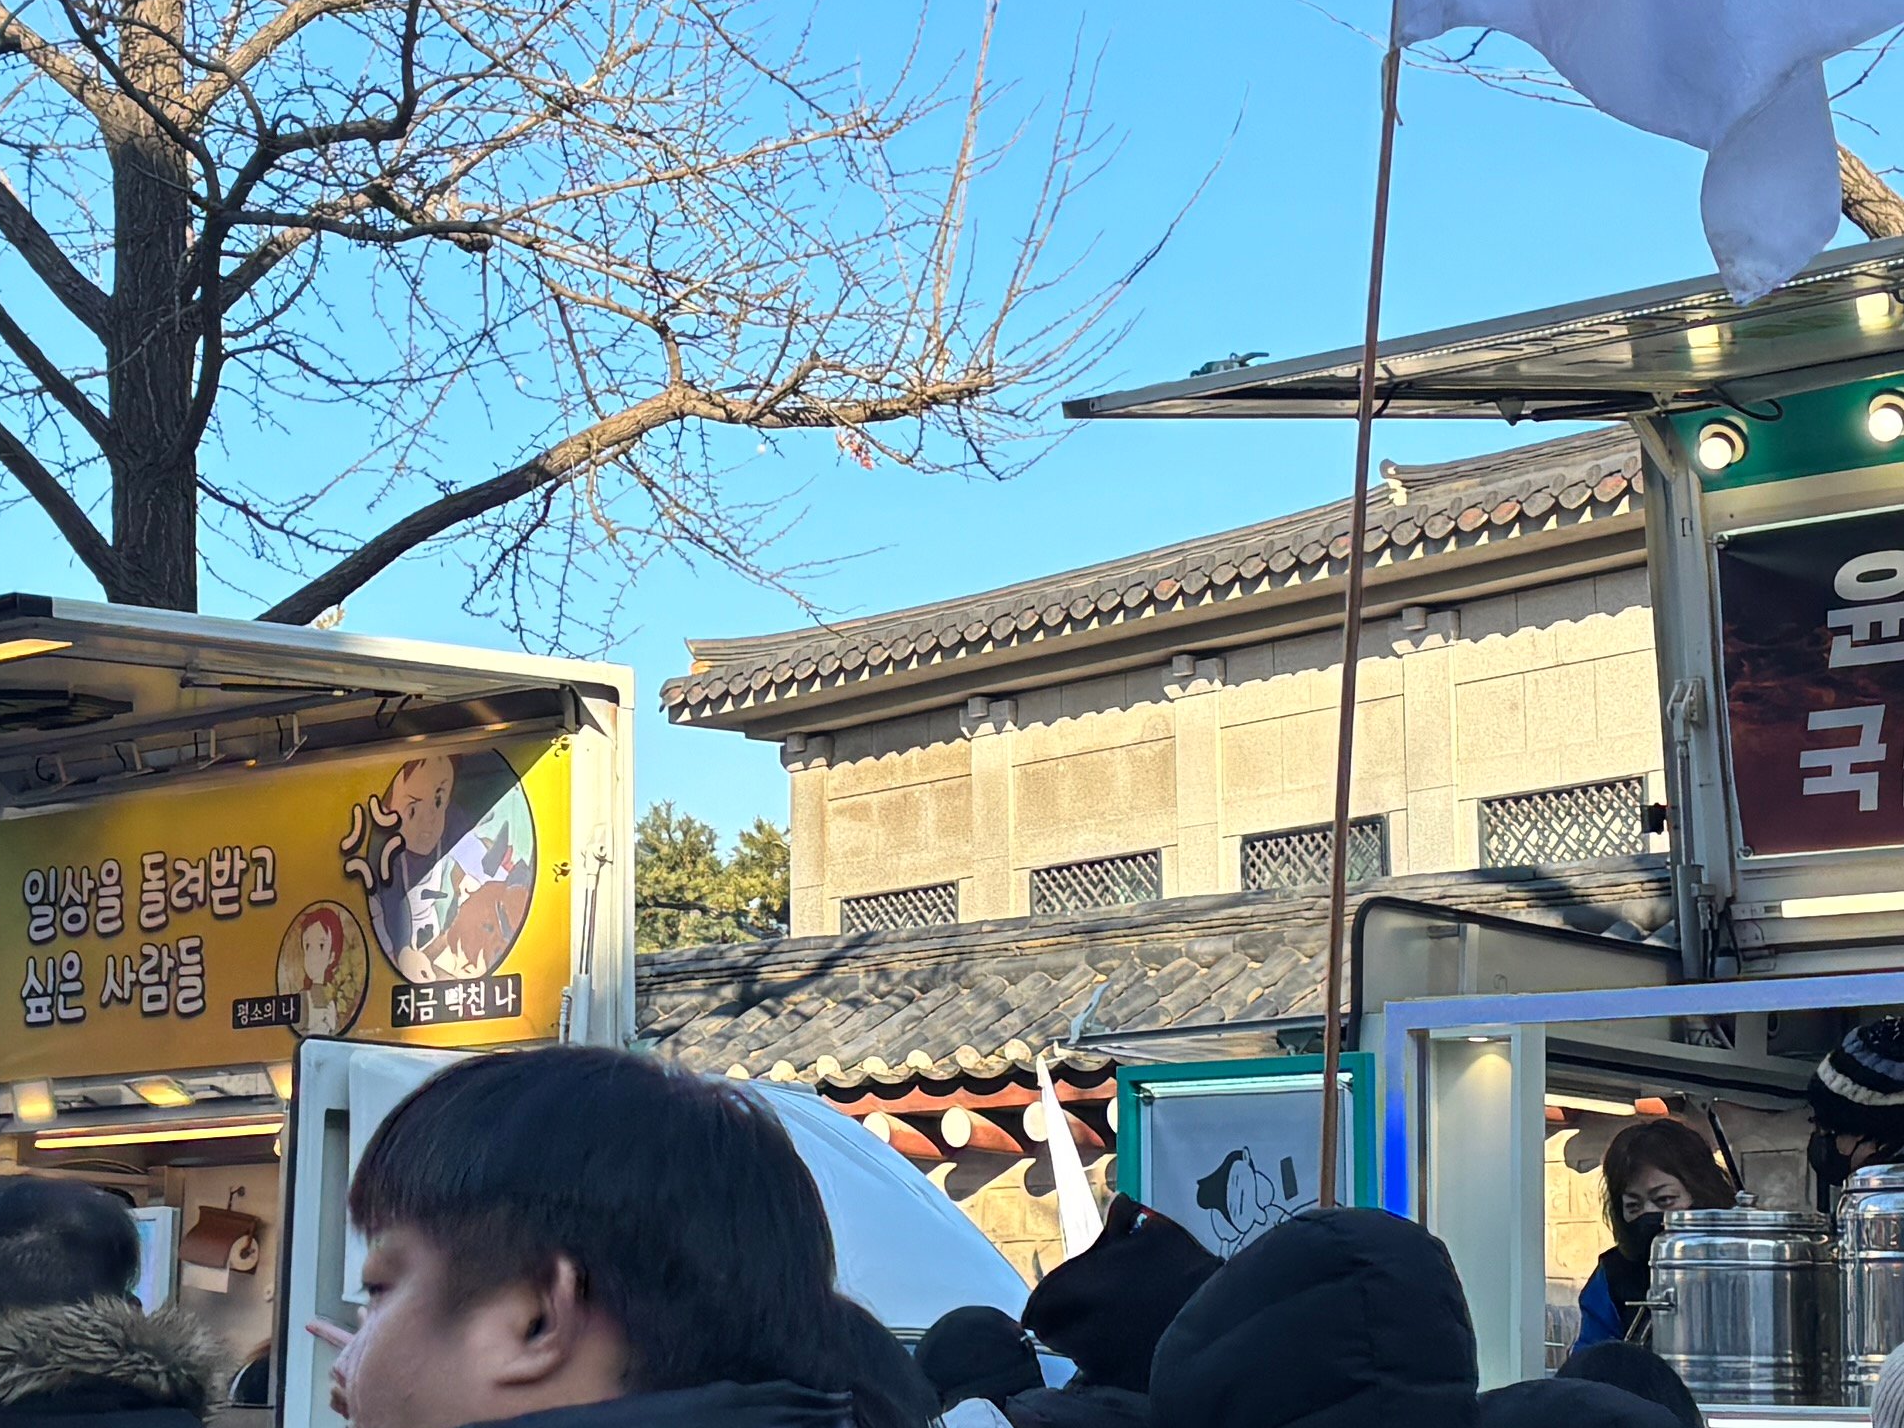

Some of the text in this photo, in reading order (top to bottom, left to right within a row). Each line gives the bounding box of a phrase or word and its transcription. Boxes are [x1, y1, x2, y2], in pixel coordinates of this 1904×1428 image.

[22, 845, 278, 945] 일상을 돌려받고
[20, 935, 207, 1027] 싶은 사람들
[236, 998, 296, 1024] 평소의 나
[396, 986, 438, 1022] 지금
[495, 978, 517, 1013] 나
